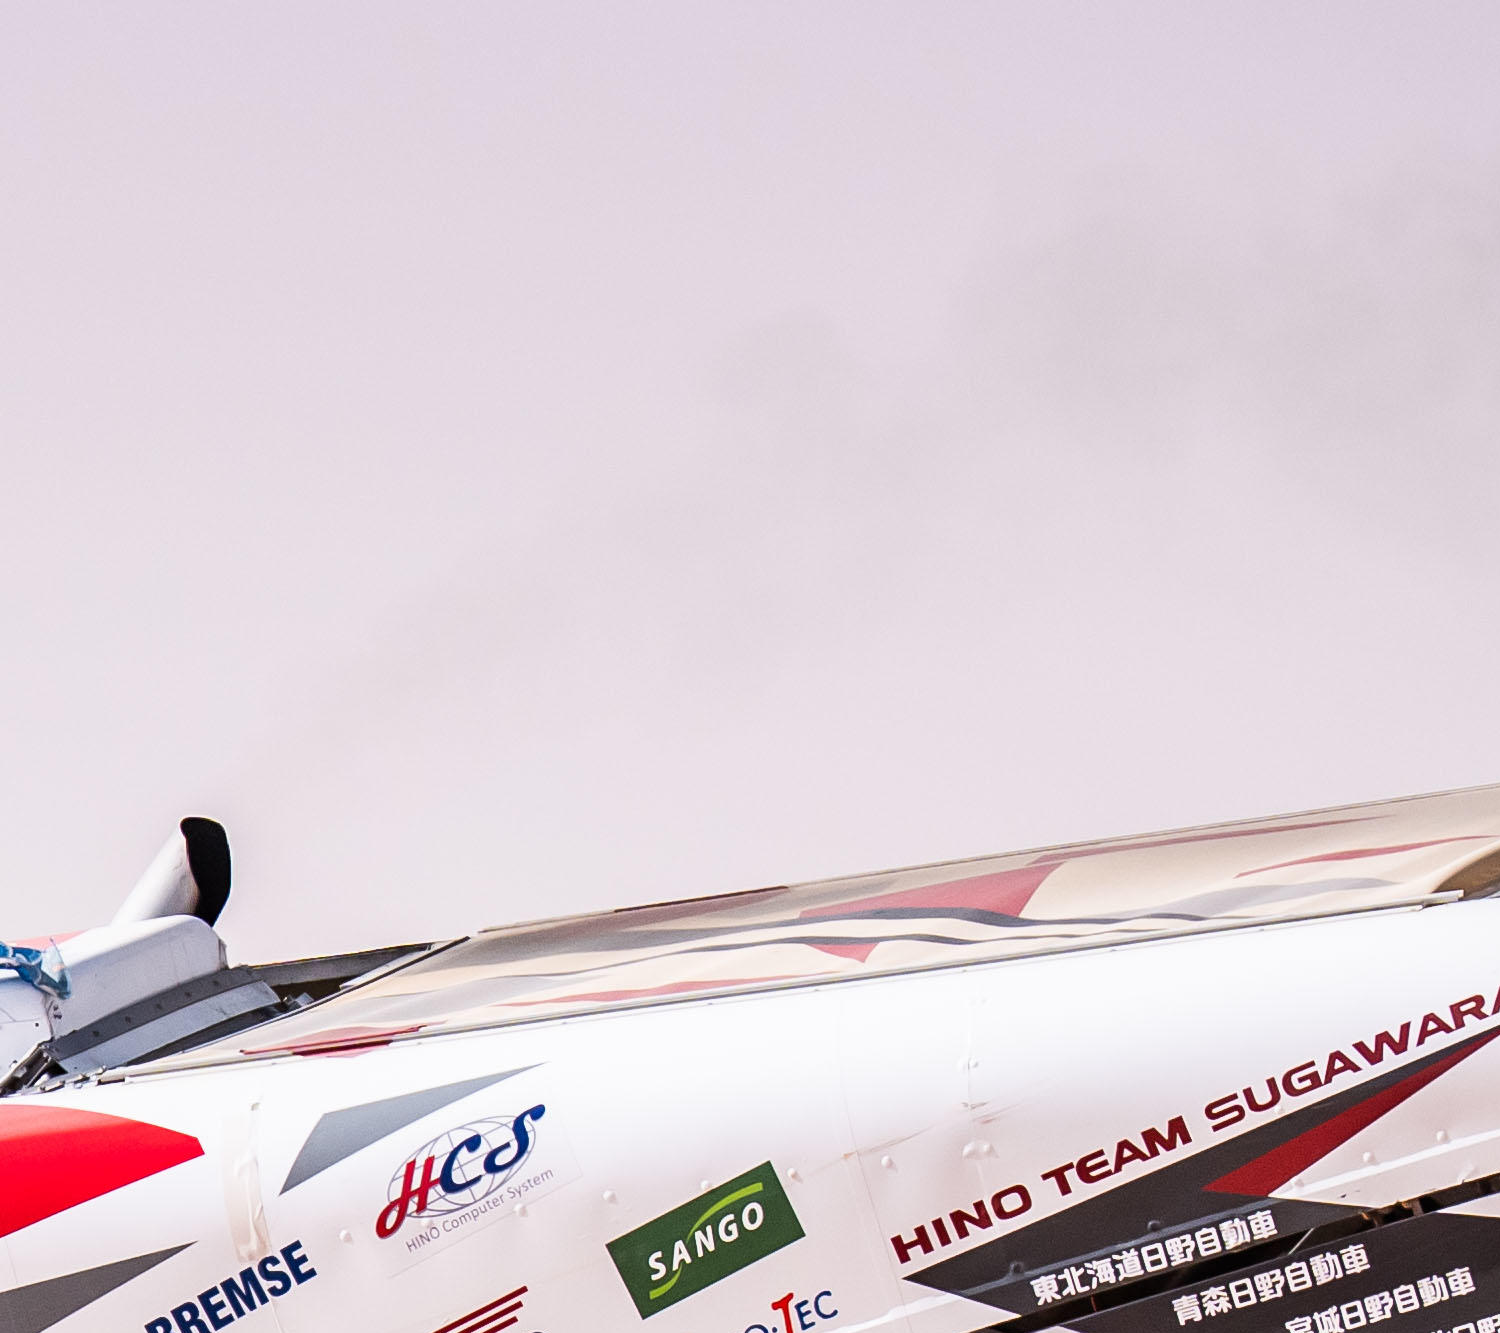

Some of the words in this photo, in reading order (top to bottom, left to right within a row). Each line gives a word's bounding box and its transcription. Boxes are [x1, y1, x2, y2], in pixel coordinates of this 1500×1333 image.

[376, 1103, 545, 1239] HCS
[405, 1224, 443, 1254] HINO
[441, 1191, 506, 1235] Computer
[504, 1167, 555, 1207] System
[891, 1182, 1032, 1265] HINO
[1040, 1114, 1193, 1197] TEAM
[648, 1200, 765, 1282] SANGO
[1030, 1209, 1279, 1306] 東北海道日野自動車
[1172, 1243, 1371, 1327] 青森日野自動車
